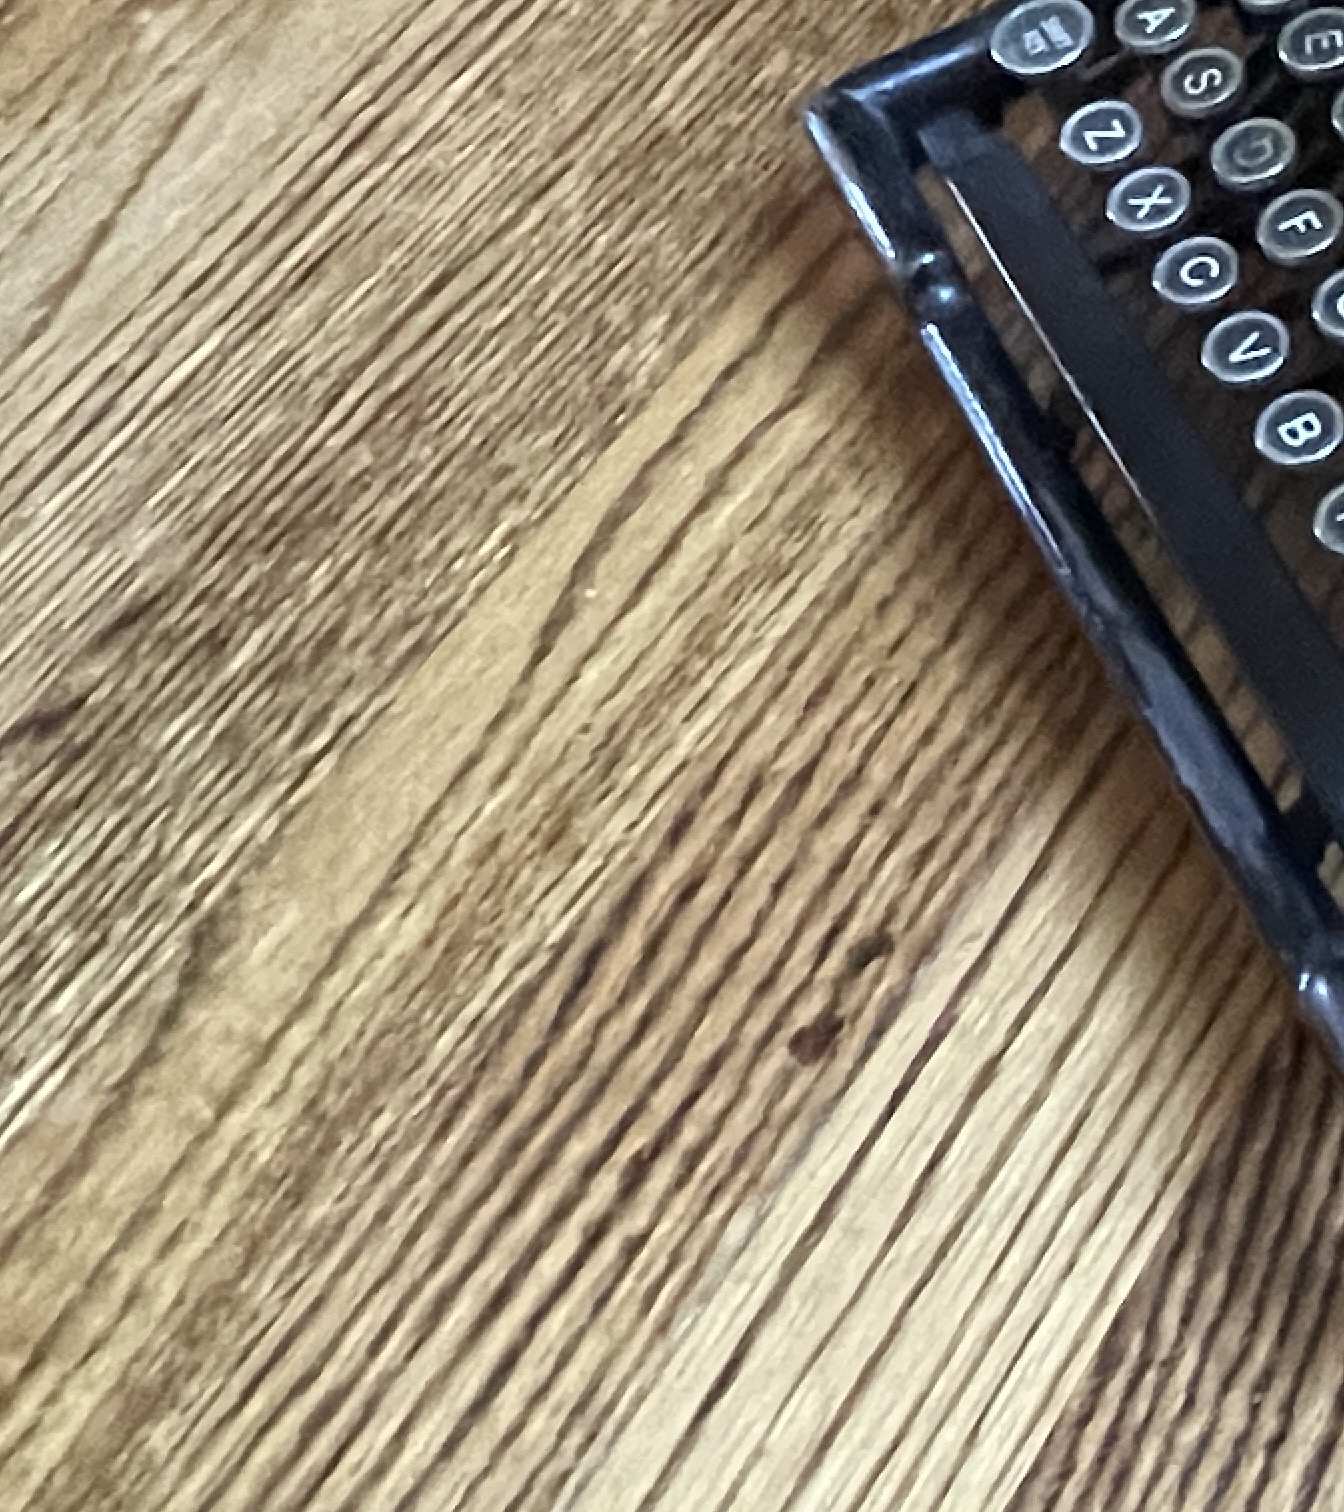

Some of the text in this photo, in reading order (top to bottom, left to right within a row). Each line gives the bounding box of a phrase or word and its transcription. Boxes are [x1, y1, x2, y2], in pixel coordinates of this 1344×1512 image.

[1135, 4, 1176, 34] A
[1305, 28, 1344, 52] E
[1183, 68, 1222, 94] S
[1083, 118, 1125, 151] Z
[1126, 186, 1172, 218] X
[1277, 208, 1323, 234] F
[1179, 255, 1219, 287] C
[1228, 332, 1271, 364] V
[1277, 412, 1323, 447] B
